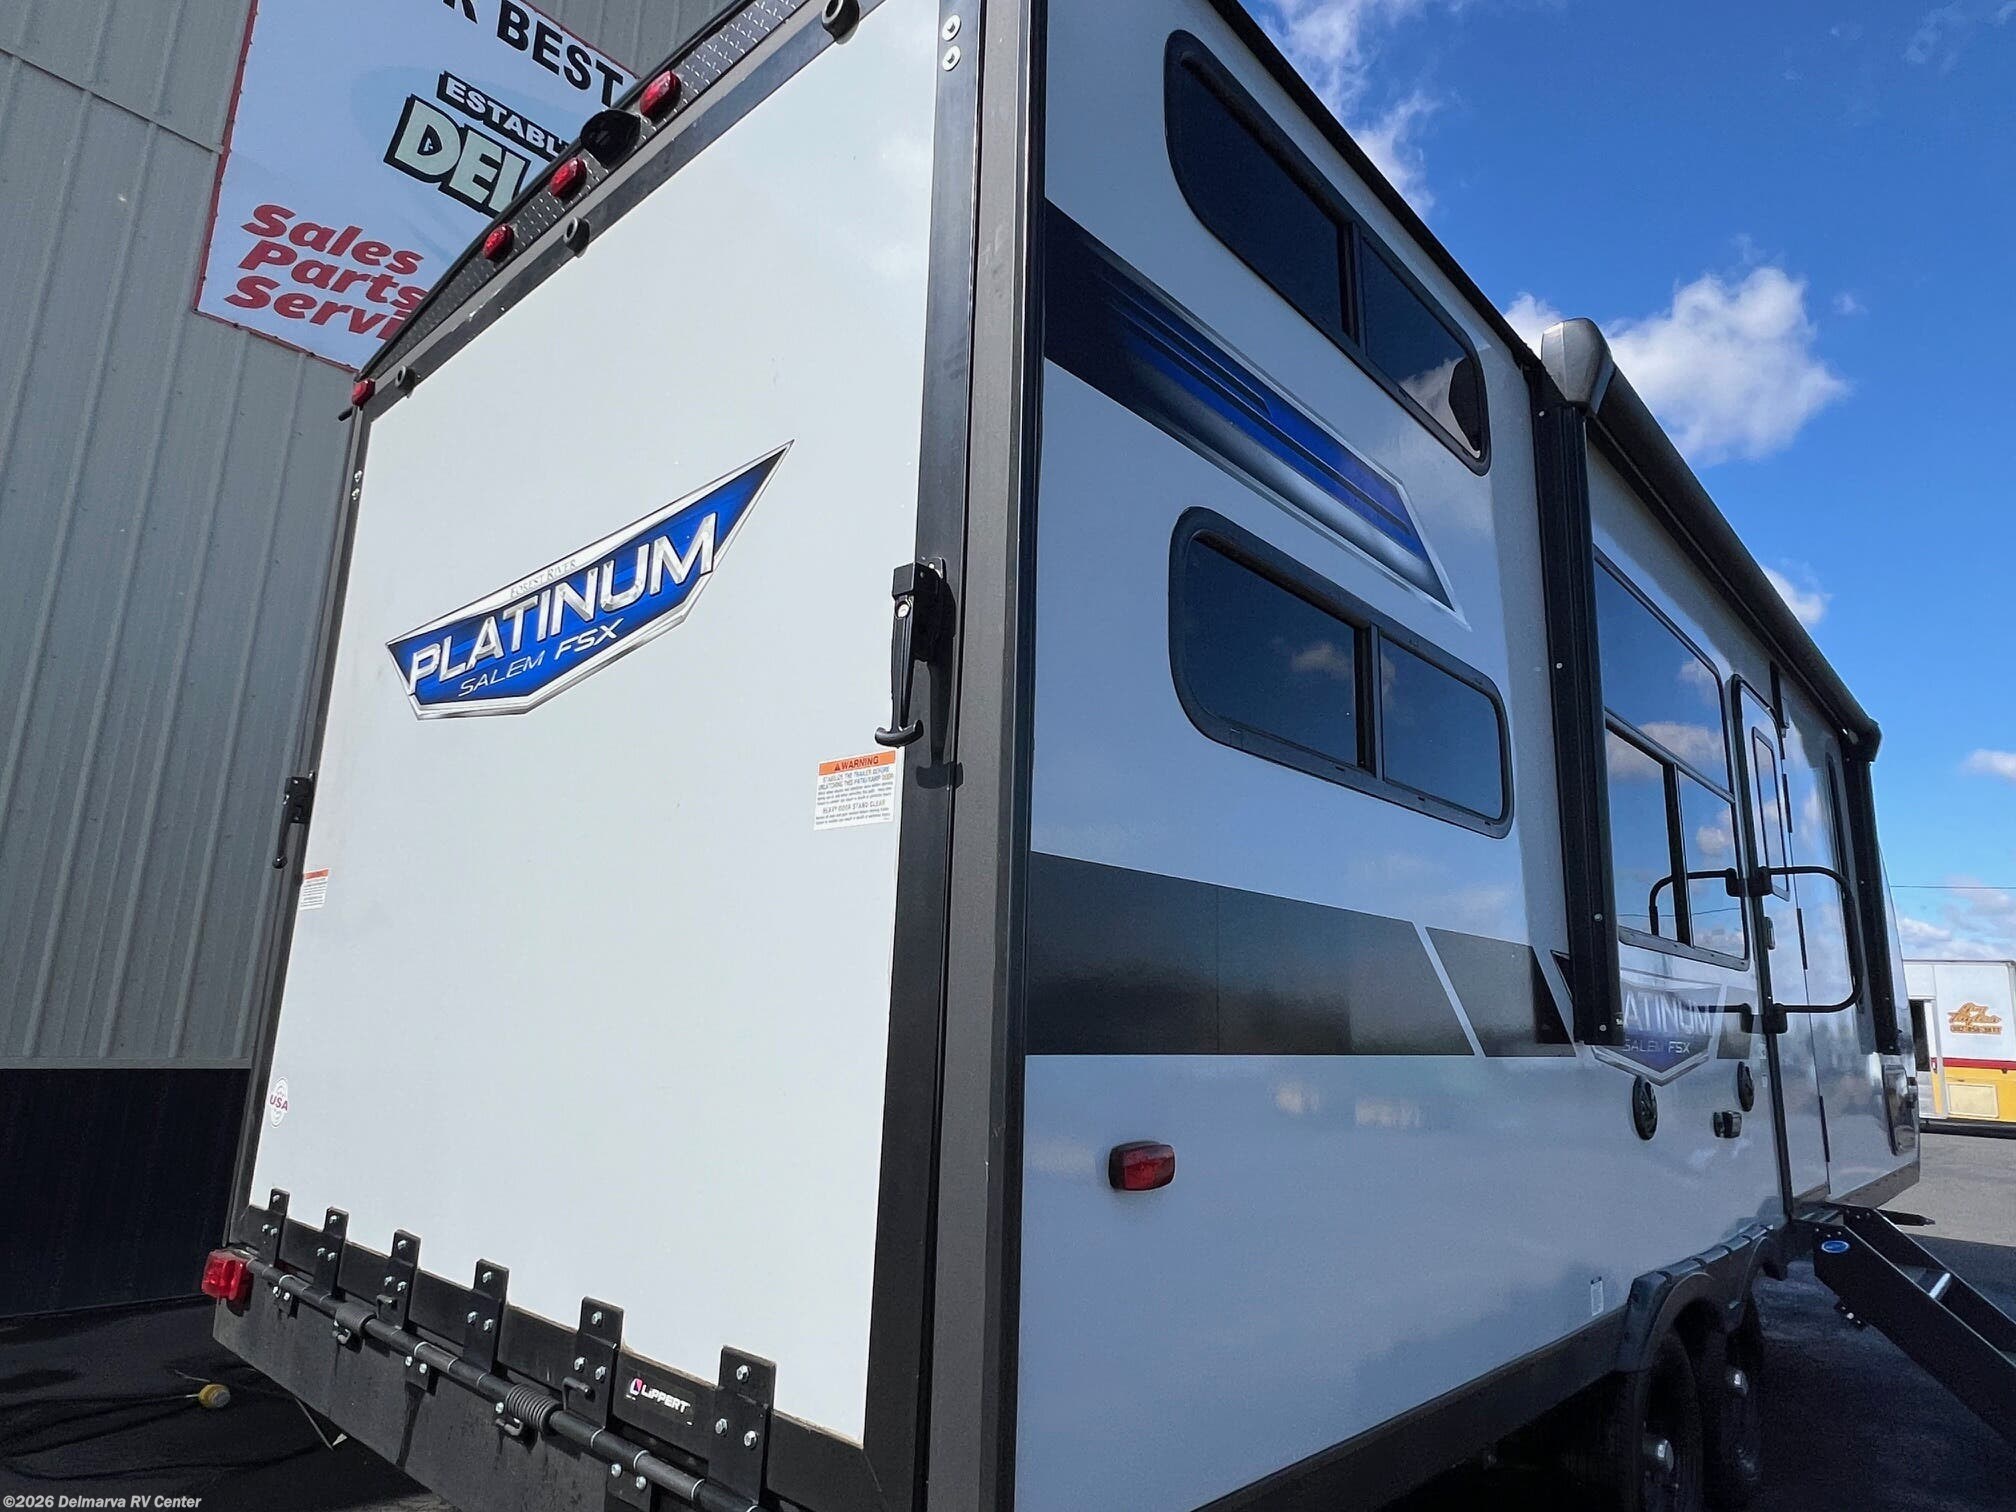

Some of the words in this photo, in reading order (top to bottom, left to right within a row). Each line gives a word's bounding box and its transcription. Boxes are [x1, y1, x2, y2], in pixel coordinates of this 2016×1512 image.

[497, 0, 624, 107] BEST
[441, 74, 567, 158] ESTABL
[238, 240, 428, 310] Parts
[241, 204, 424, 275] Sales
[408, 512, 718, 695] PLATINUM
[458, 650, 545, 697] SALEM
[554, 617, 624, 661] FSX
[841, 756, 879, 770] WARNING
[1668, 1040, 1691, 1054] FSX
[269, 1094, 288, 1111] USA
